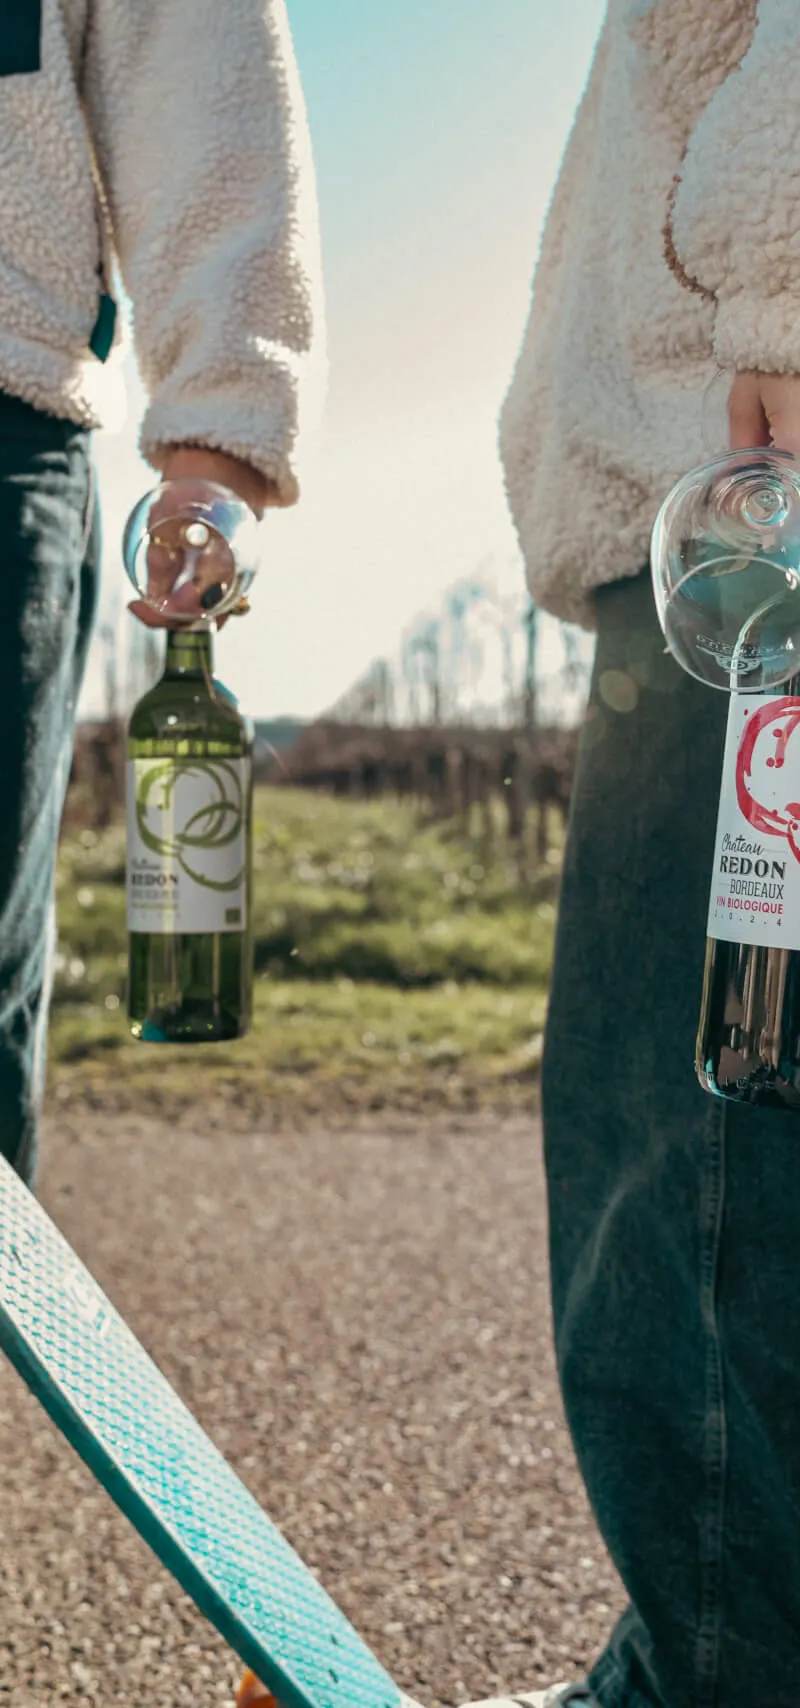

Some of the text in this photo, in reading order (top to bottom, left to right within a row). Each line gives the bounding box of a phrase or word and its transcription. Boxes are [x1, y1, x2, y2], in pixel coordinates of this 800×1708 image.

[720, 856, 787, 880] REDON
[729, 879, 785, 899] BORDEAUX
[727, 897, 784, 915] BIOLOGIQUE
